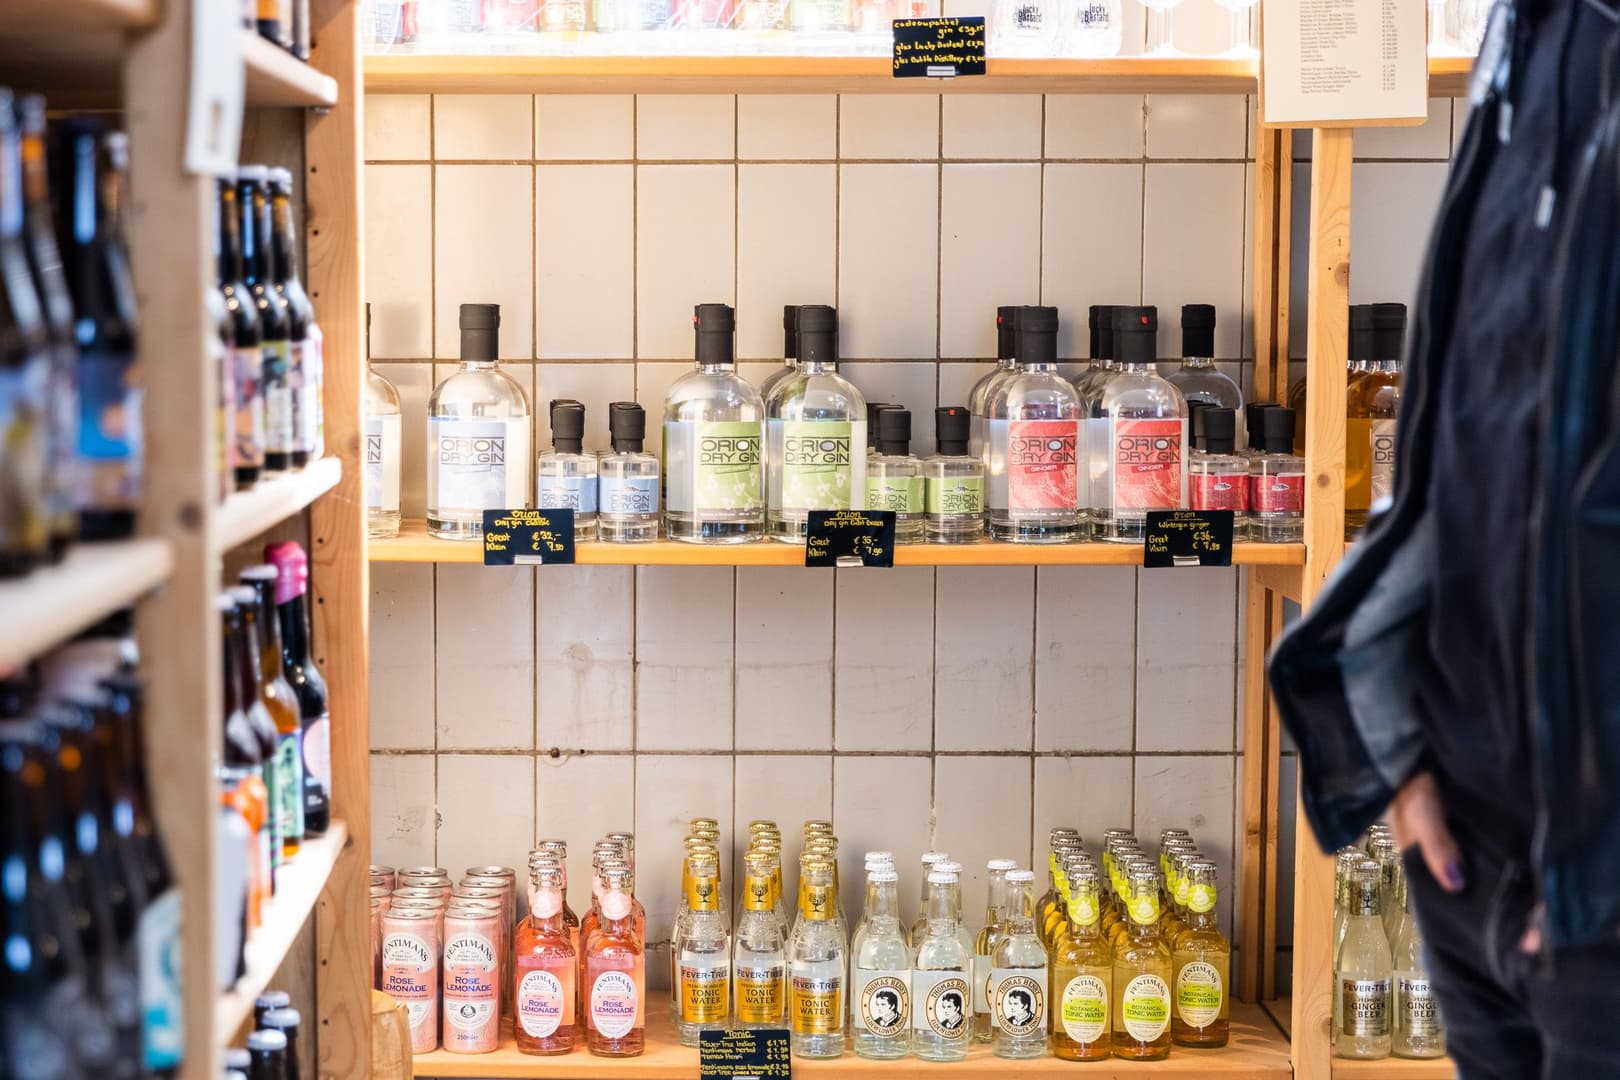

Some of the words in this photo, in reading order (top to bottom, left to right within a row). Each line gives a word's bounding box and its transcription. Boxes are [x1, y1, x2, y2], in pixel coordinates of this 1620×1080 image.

[441, 439, 505, 452] ORION
[702, 439, 760, 452] ORION
[785, 439, 850, 452] ORION
[1011, 438, 1076, 451] ORION
[1118, 438, 1180, 451] ORION
[367, 451, 381, 461] IN
[477, 453, 505, 463] GIN
[702, 453, 735, 463] DRY
[738, 453, 760, 463] GIN
[785, 453, 819, 463] DRY
[822, 453, 850, 463] GIN
[1011, 452, 1047, 463] DRY
[1050, 451, 1076, 463] GIN
[1118, 451, 1153, 463] DRY
[1156, 451, 1180, 462] GIN
[446, 939, 493, 963] FENTIMANS
[1182, 965, 1217, 982] FENTIMANS
[389, 976, 415, 985] ROSE
[454, 976, 481, 985] ROSE
[522, 975, 558, 993] FENTIMANS
[596, 975, 632, 993] FENTIMANS
[793, 981, 840, 990] FEVER-TREE
[383, 981, 427, 992] LEMONADE
[446, 982, 492, 992] LEMONADE
[865, 979, 889, 995] THOMAS
[890, 979, 907, 995] HENRY
[931, 980, 956, 998] THOMAS
[999, 979, 1022, 994] THOMAS
[1023, 979, 1041, 994] HENRY
[1068, 980, 1104, 997] FENTIMANS
[1130, 979, 1165, 997] FENTIMANS
[692, 989, 720, 997] TONIC
[746, 989, 776, 997] TONIC
[528, 1000, 550, 1008] ROSE
[602, 1000, 624, 1008] ROSE
[690, 996, 721, 1005] WATER
[745, 996, 777, 1005] WATER
[801, 1000, 830, 1008] TONIC
[521, 1004, 560, 1014] LEMONADE
[595, 1004, 635, 1014] LEMONADE
[1351, 1002, 1386, 1010] GINGER
[800, 1007, 831, 1016] WATER
[1357, 1010, 1382, 1018] BEER
